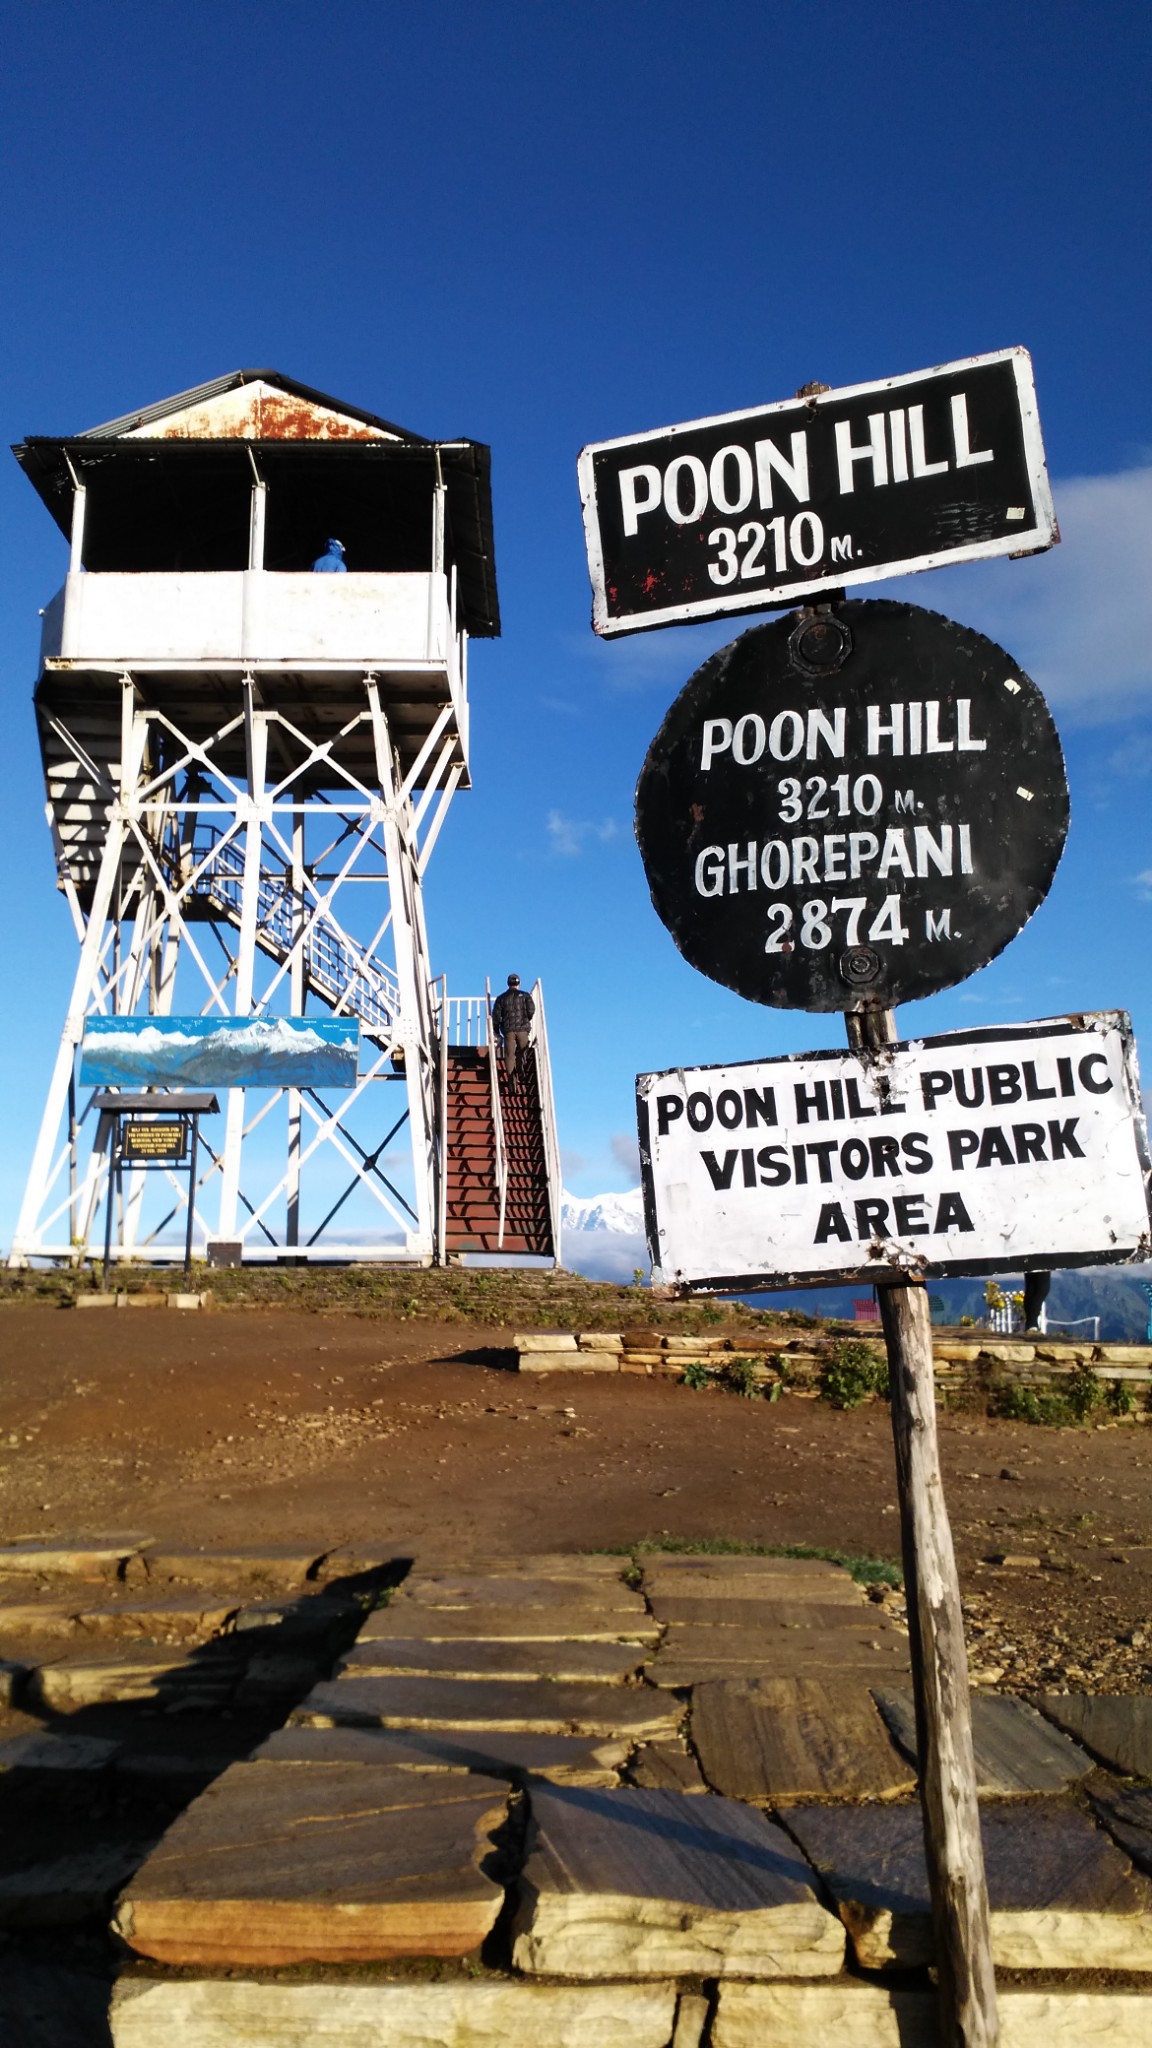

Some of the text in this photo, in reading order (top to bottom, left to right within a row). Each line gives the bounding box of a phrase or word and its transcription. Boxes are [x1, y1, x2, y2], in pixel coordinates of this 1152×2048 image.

[617, 392, 994, 537] POON HILL
[706, 511, 864, 586] 3210 M.
[700, 698, 987, 771] POON HILL
[777, 773, 883, 824] 3210
[695, 824, 974, 898] GHOREPANI
[764, 894, 963, 954] 2874 M.
[657, 1052, 1114, 1136] POON HILL PUBLIC
[699, 1116, 1087, 1192] VISITORS PARK
[813, 1191, 976, 1245] AREA
